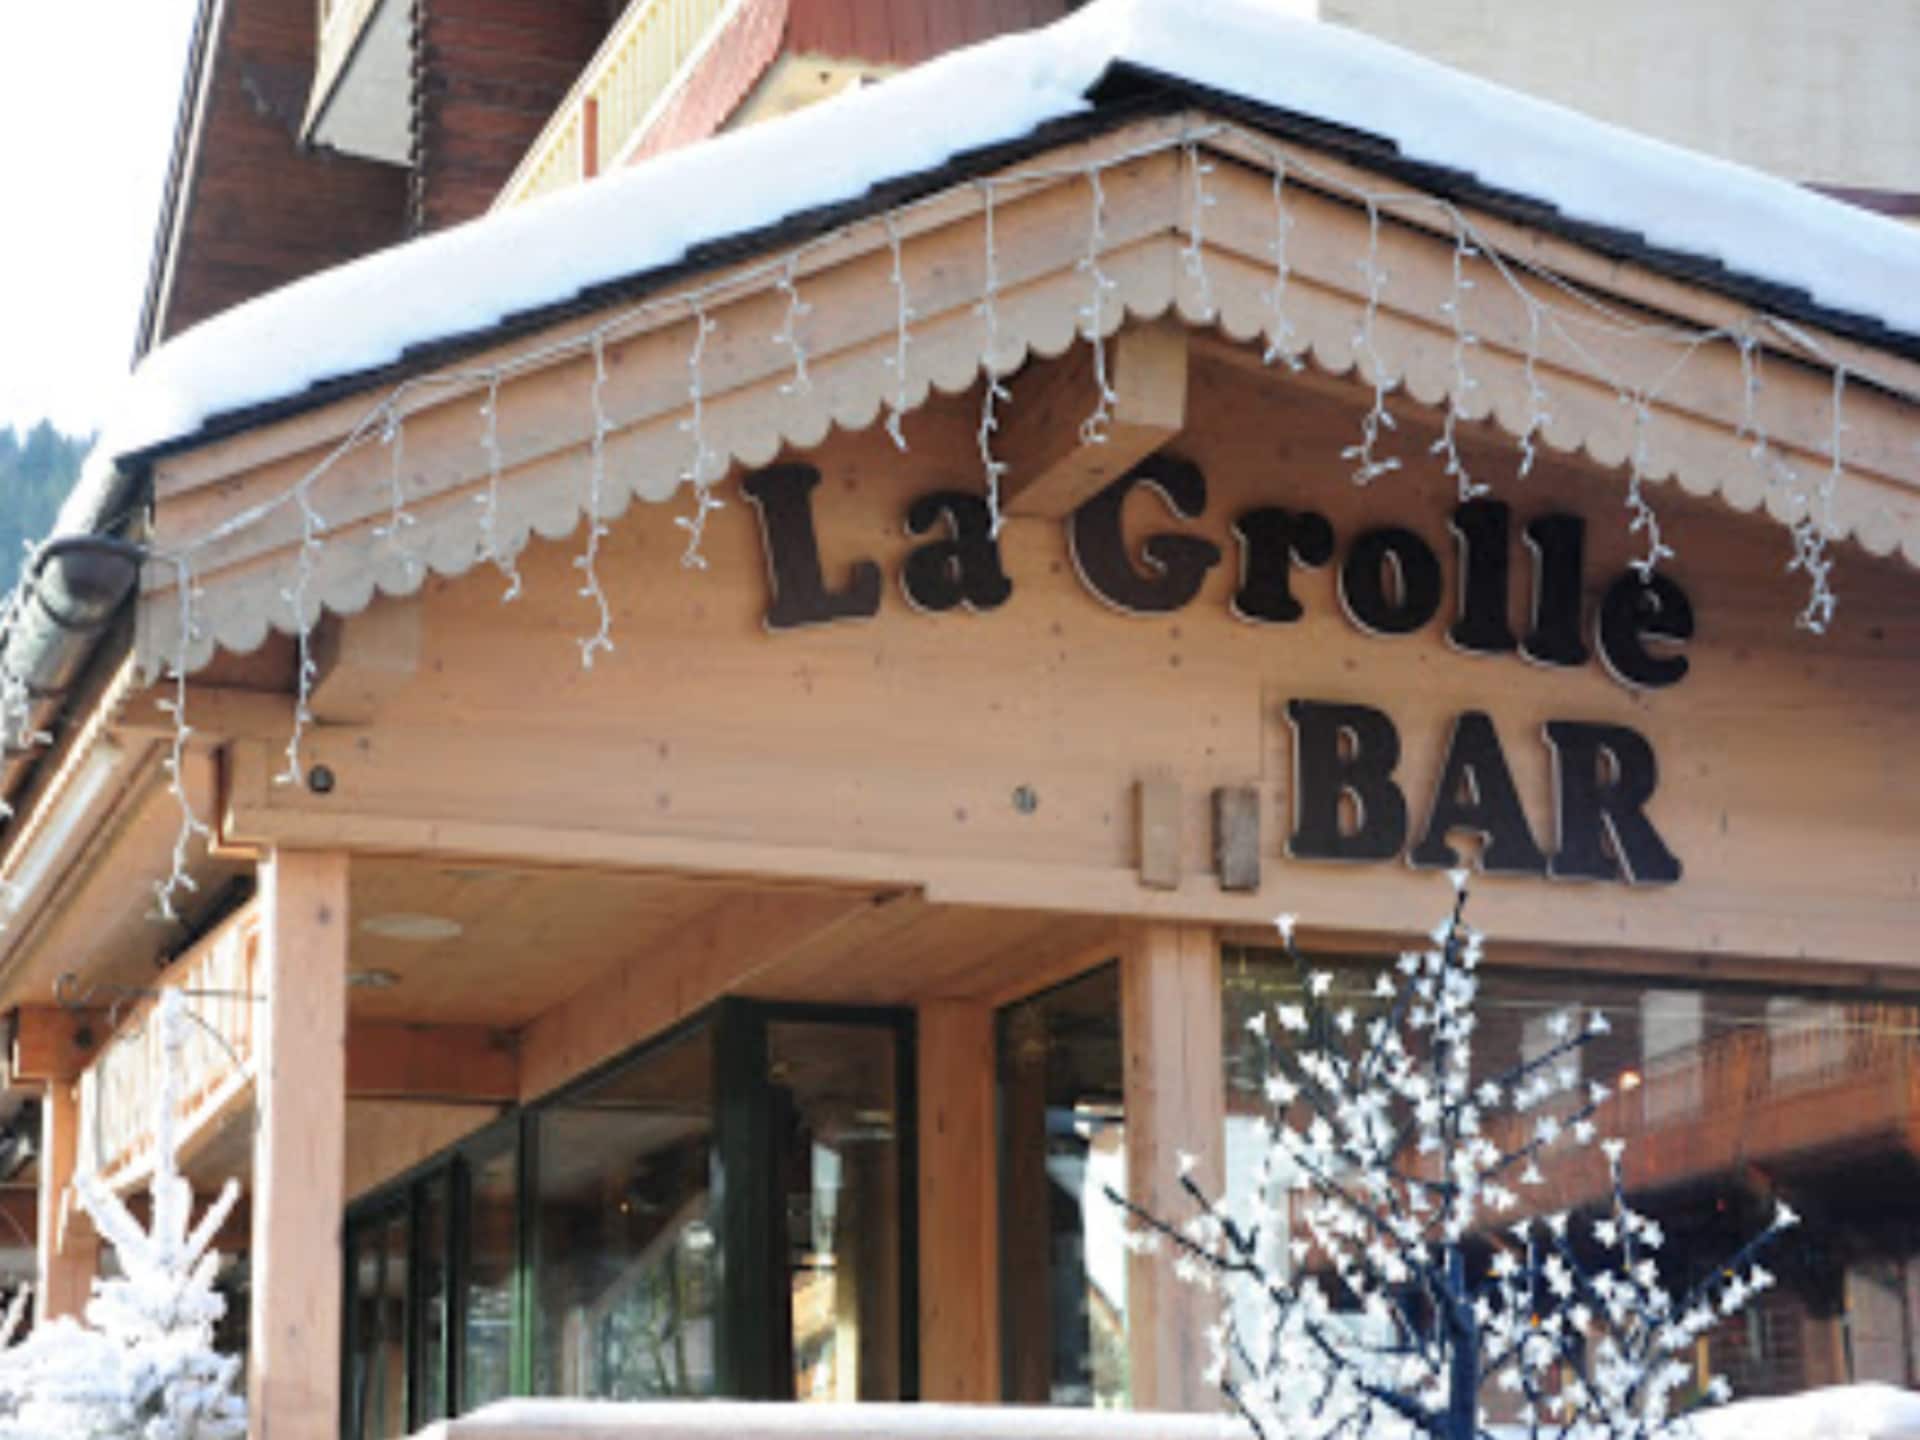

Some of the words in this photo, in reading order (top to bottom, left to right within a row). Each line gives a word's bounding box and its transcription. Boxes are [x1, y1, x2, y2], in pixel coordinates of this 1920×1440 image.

[740, 463, 1012, 632] La
[1066, 454, 1695, 688] Grolle
[1284, 699, 1683, 884] BAR
